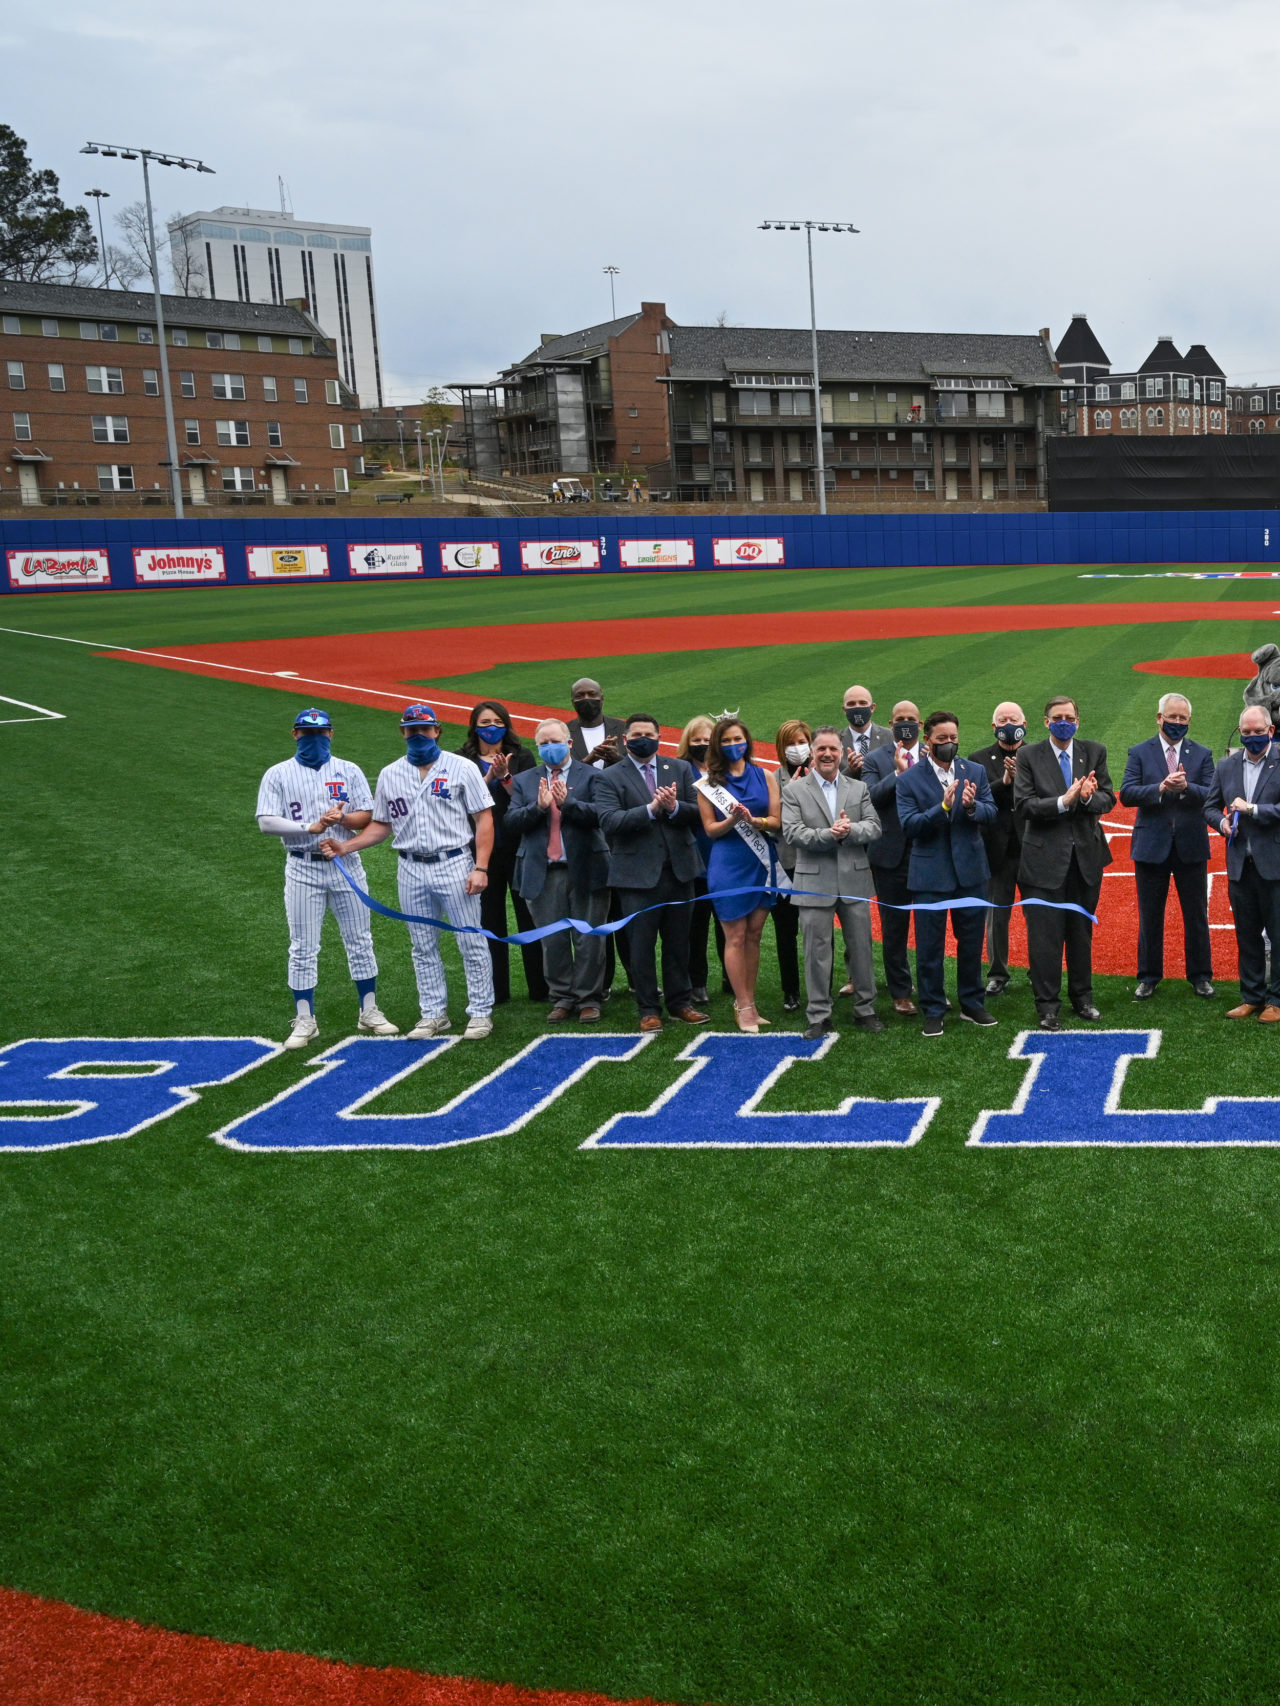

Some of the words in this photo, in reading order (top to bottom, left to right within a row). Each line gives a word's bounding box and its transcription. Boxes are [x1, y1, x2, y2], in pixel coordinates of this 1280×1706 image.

[740, 546, 760, 557] DQ
[147, 553, 213, 573] Johnny's
[289, 801, 303, 820] 2
[387, 797, 409, 819] 30
[711, 788, 727, 806] Miss
[750, 832, 766, 855] Tech
